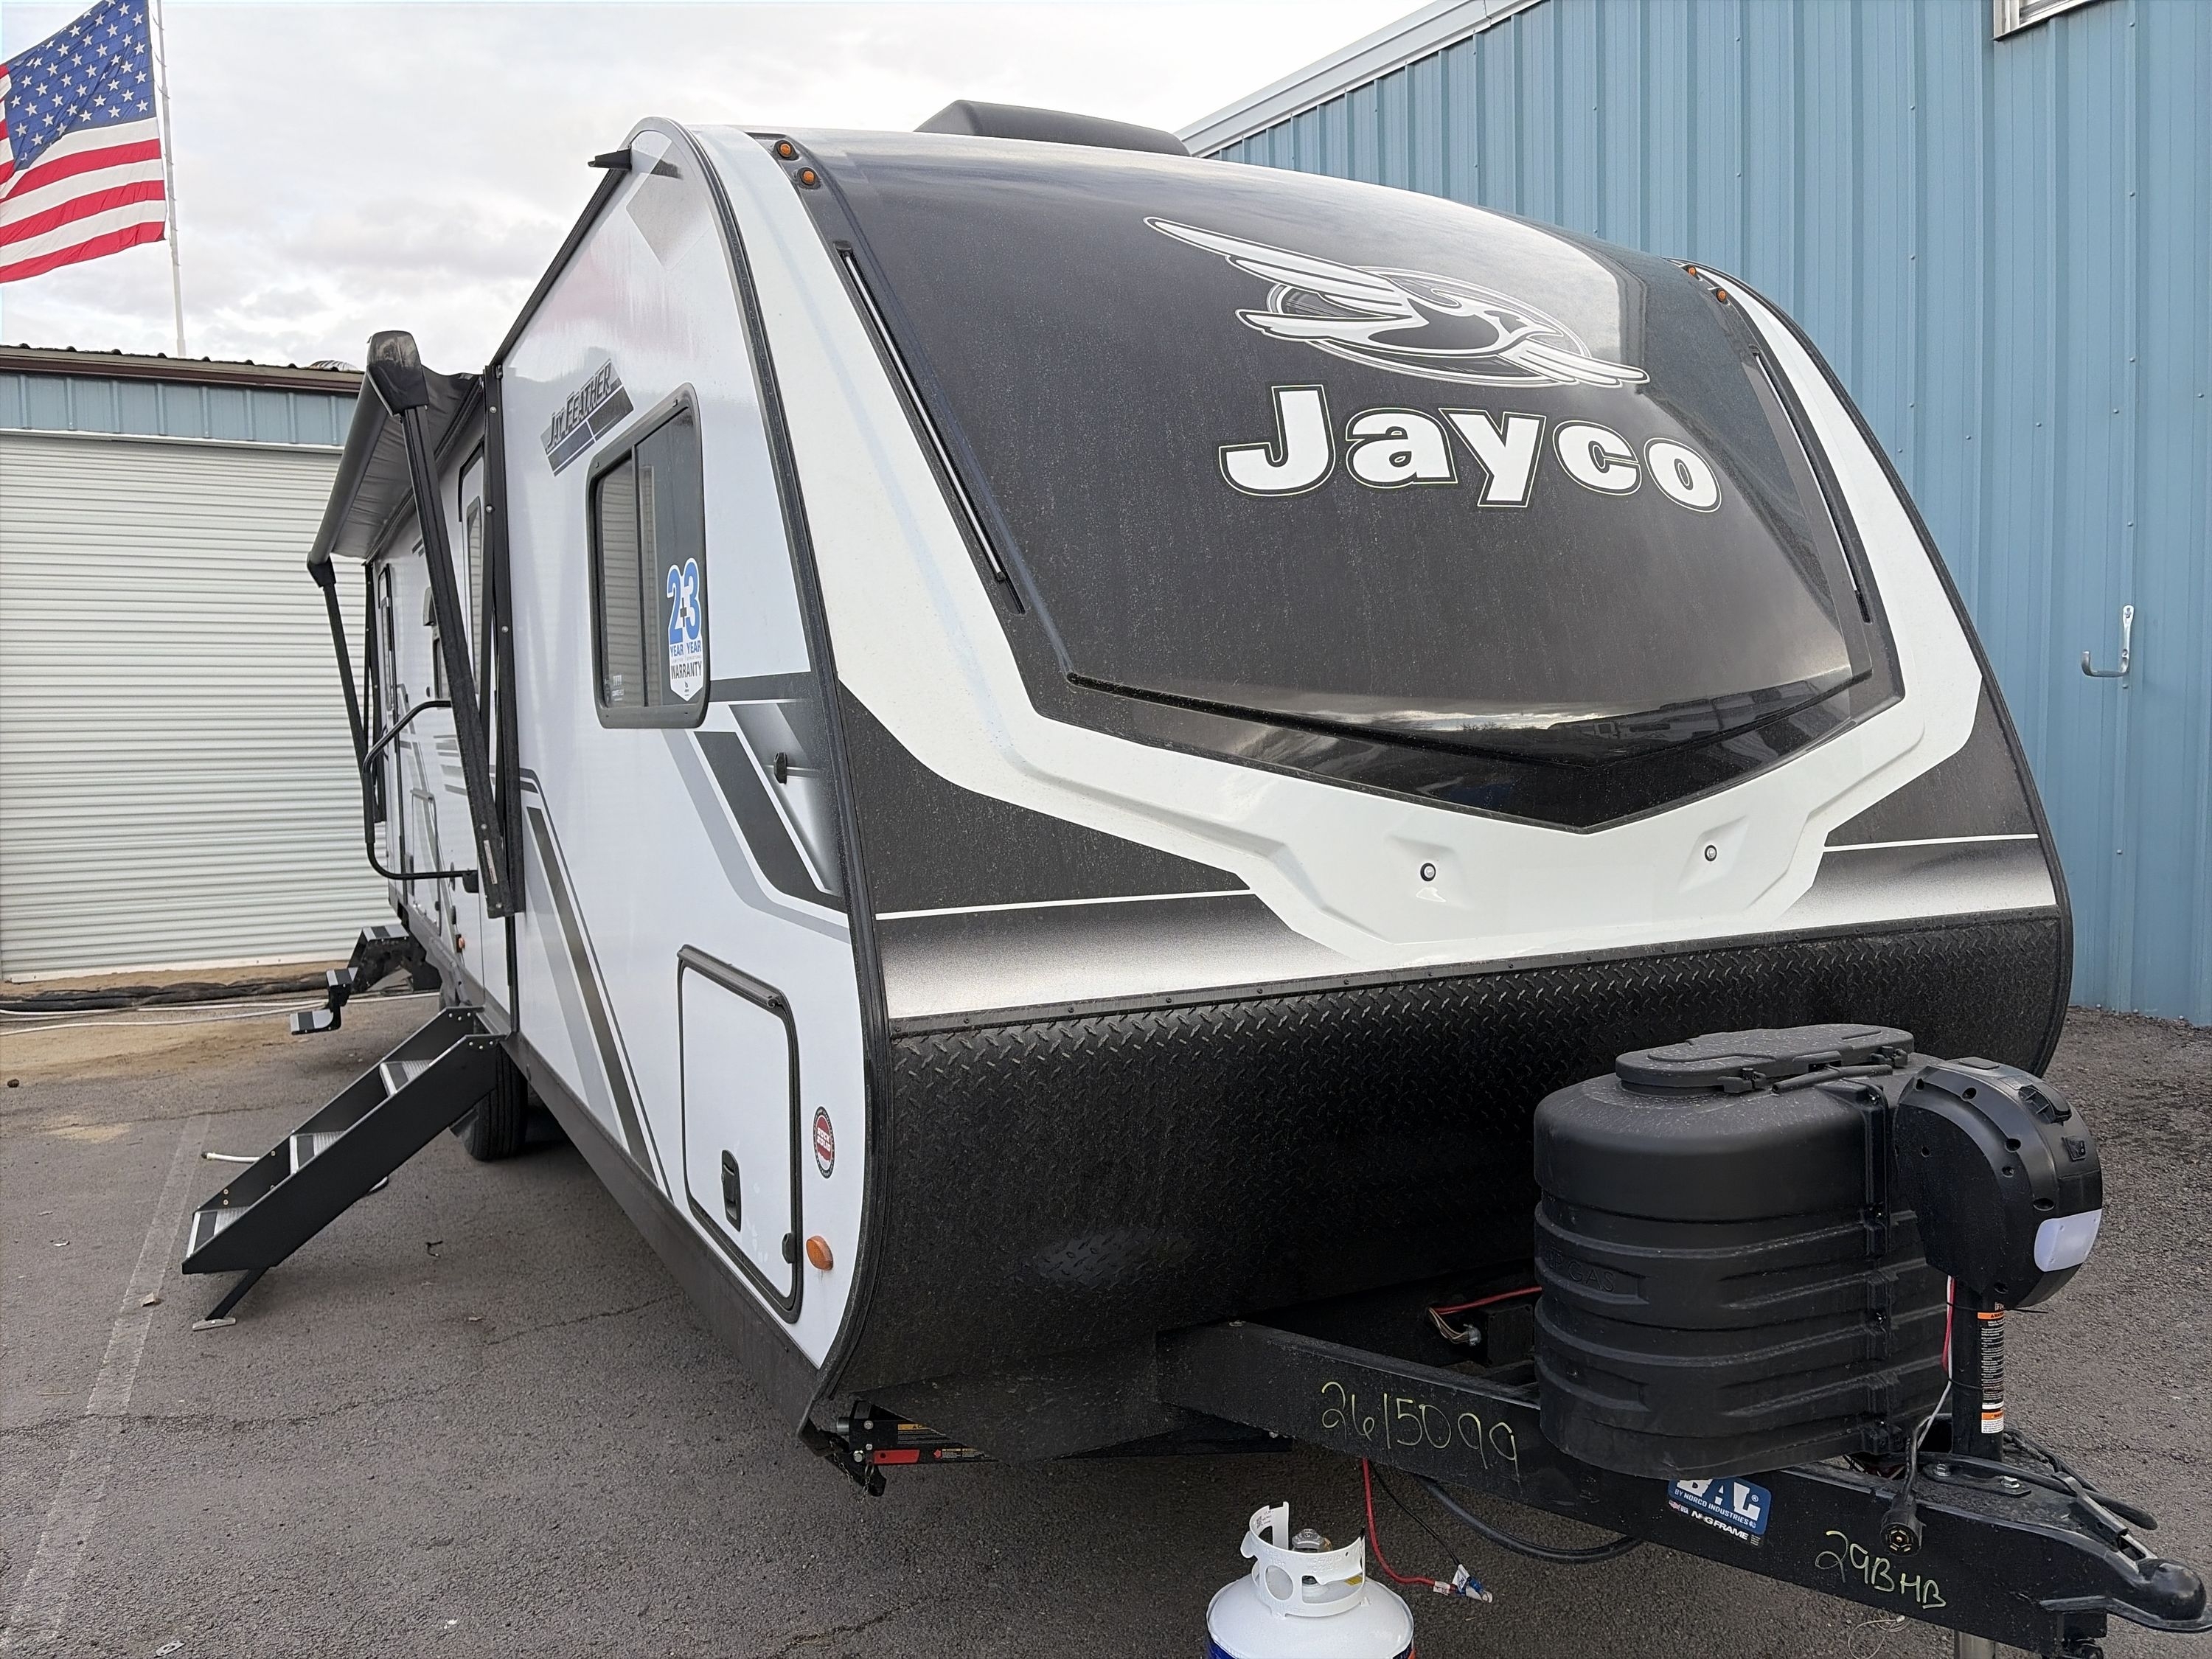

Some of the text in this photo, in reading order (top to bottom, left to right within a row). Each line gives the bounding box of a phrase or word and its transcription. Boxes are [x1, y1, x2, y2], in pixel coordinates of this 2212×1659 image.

[546, 358, 612, 455] JAY FEATHER
[1218, 383, 1722, 512] Jayco
[670, 641, 701, 657] YEAR YEAR
[671, 661, 702, 679] WARRANTY
[816, 1136, 831, 1152] SOLID
[817, 1127, 830, 1142] ROCK
[1568, 1260, 1615, 1293] GAS
[1321, 1381, 1521, 1486] 2615099
[1674, 1489, 1750, 1526] BY NORCO INDUSTRIES
[1713, 1520, 1750, 1540] FRAME
